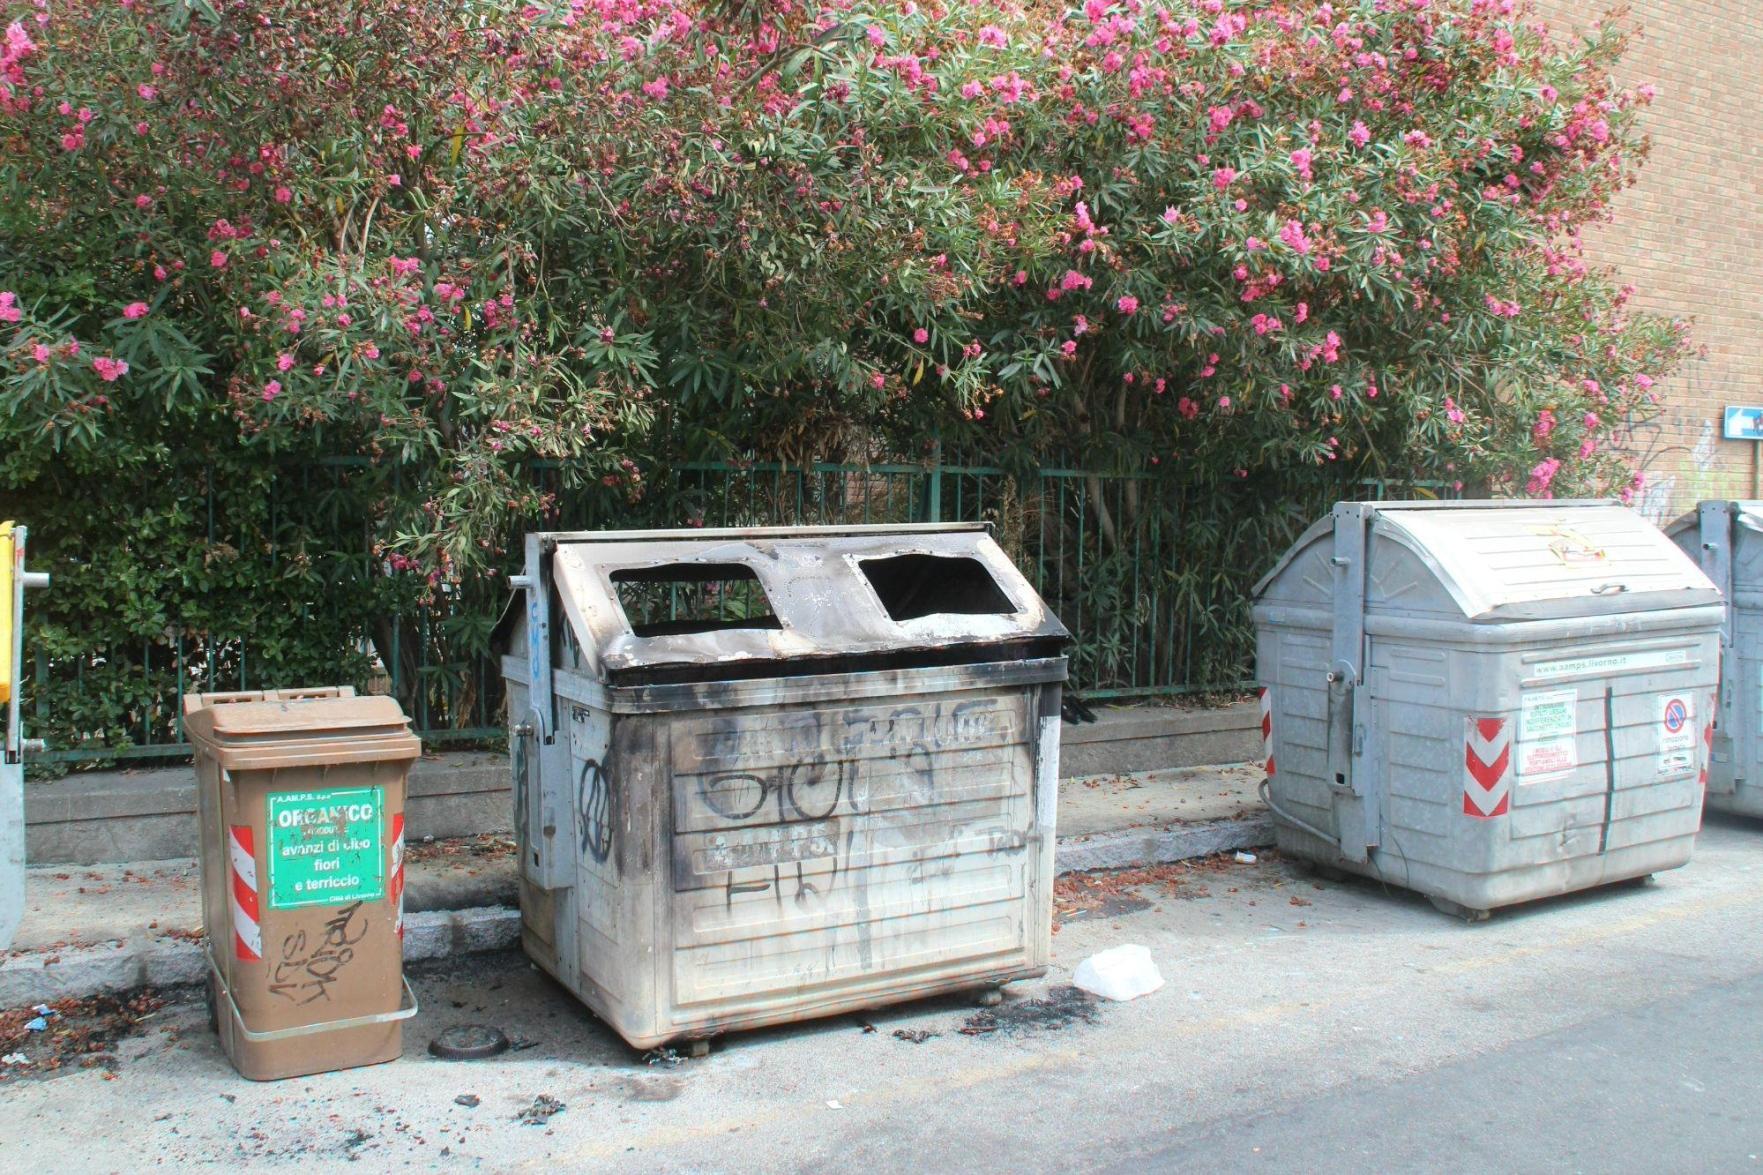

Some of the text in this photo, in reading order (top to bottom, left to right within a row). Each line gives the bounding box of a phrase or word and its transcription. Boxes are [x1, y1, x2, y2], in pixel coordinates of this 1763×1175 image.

[327, 838, 340, 852] di
[313, 856, 341, 872] fiori
[294, 873, 360, 892] e terriccio
